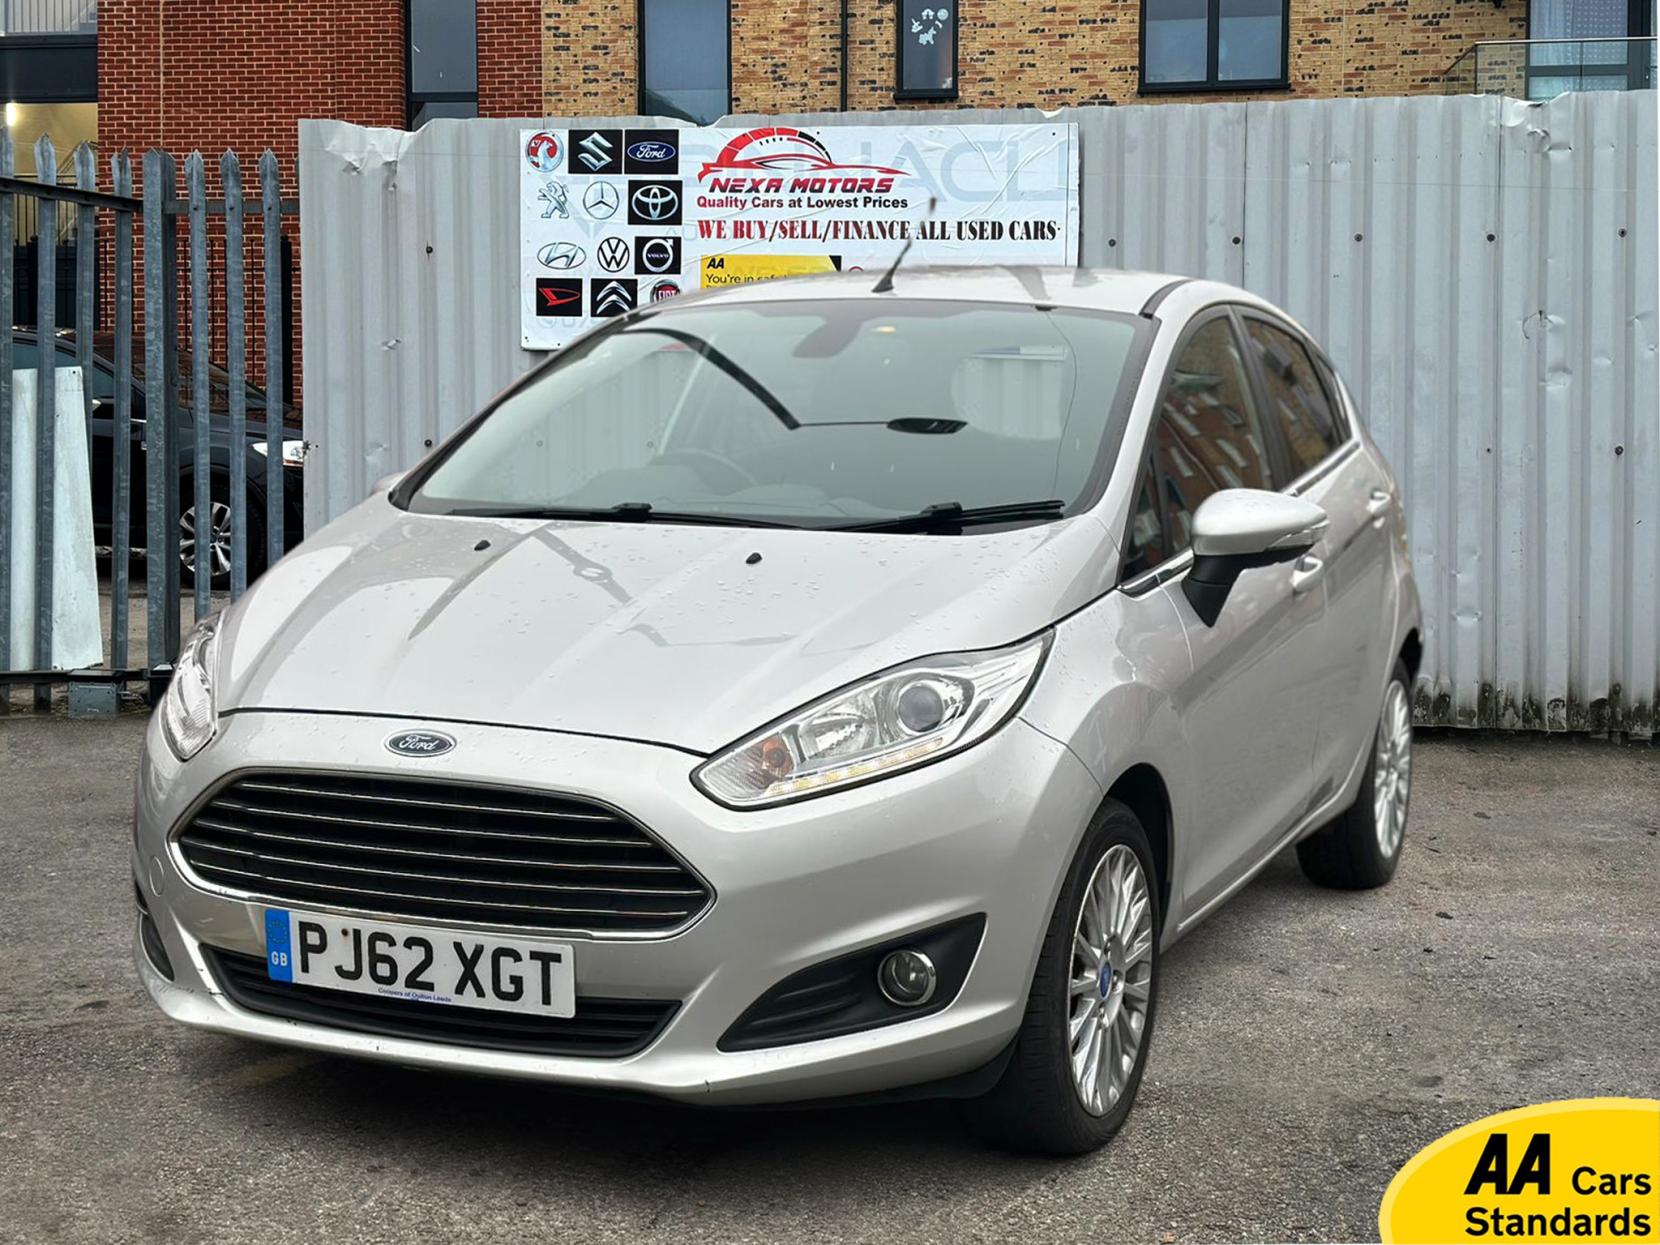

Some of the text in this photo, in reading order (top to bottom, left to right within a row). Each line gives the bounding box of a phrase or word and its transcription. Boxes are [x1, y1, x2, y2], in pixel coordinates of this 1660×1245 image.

[636, 143, 667, 159] Ford
[709, 177, 895, 193] NEXA MOTORS
[697, 196, 909, 210] Quality Cars at Lowest Prices
[698, 219, 726, 240] WE
[916, 220, 951, 240] ALL
[957, 220, 1004, 240] USED
[1009, 219, 1056, 240] CARS
[706, 257, 725, 269] AA
[706, 273, 741, 284] You're
[399, 734, 440, 751] Ford
[270, 951, 288, 967] GB
[297, 920, 563, 1007] PJ62 XGT
